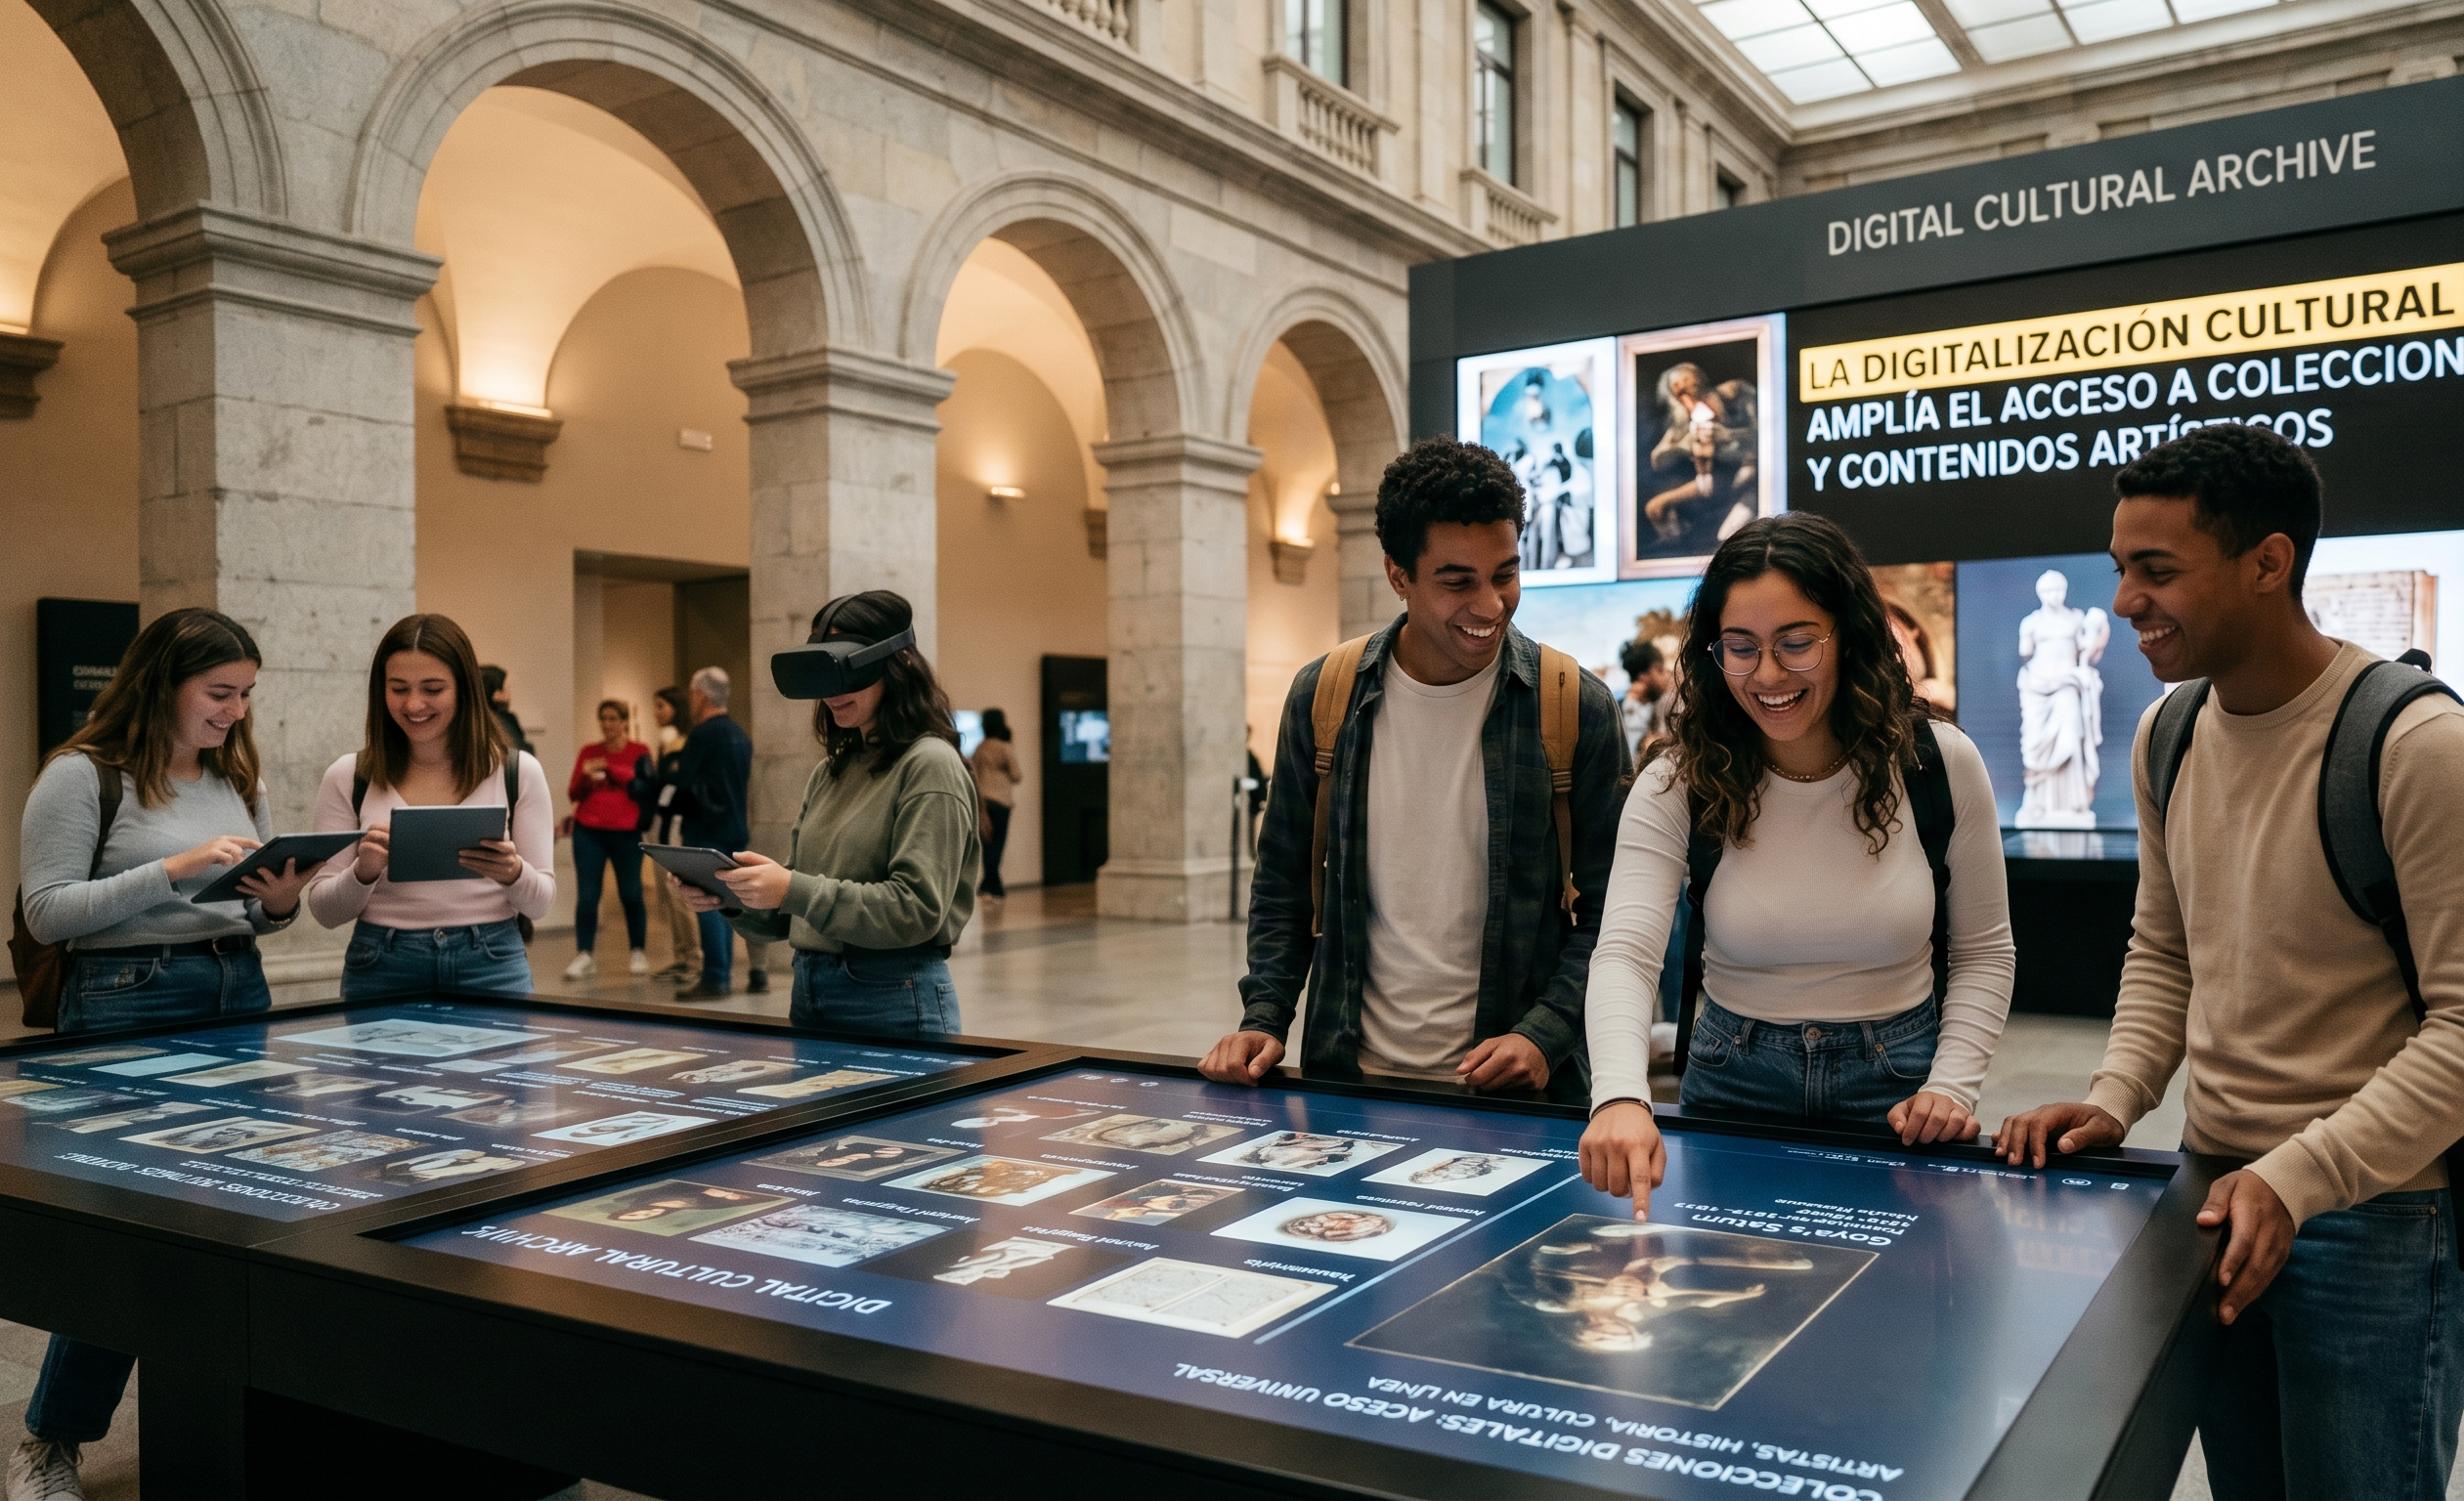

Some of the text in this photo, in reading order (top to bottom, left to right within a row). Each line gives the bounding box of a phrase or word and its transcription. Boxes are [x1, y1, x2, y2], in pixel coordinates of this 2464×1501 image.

[1829, 130, 2376, 255] DIGITAL CULTURAL ARCHIVE
[1810, 282, 2455, 391] LA DIGITALIZACIÓN CULTURAL
[1806, 335, 2464, 443] AMPLÍA EL ACCESO A COLECCION
[1806, 408, 2334, 492] Y CONTENIDOS ARTÍOS
[1788, 1224, 1892, 1247] Goya's
[595, 1248, 755, 1288] CULTURAL
[1174, 1362, 1321, 1403] UNIVERSAL
[1367, 1376, 1443, 1400] LÍNEA
[1446, 1389, 1485, 1407] EN
[1323, 1392, 1436, 1424] ACESO
[1605, 1416, 1745, 1454] HISTORIA,
[1751, 1441, 1905, 1482] ARTISTAS,
